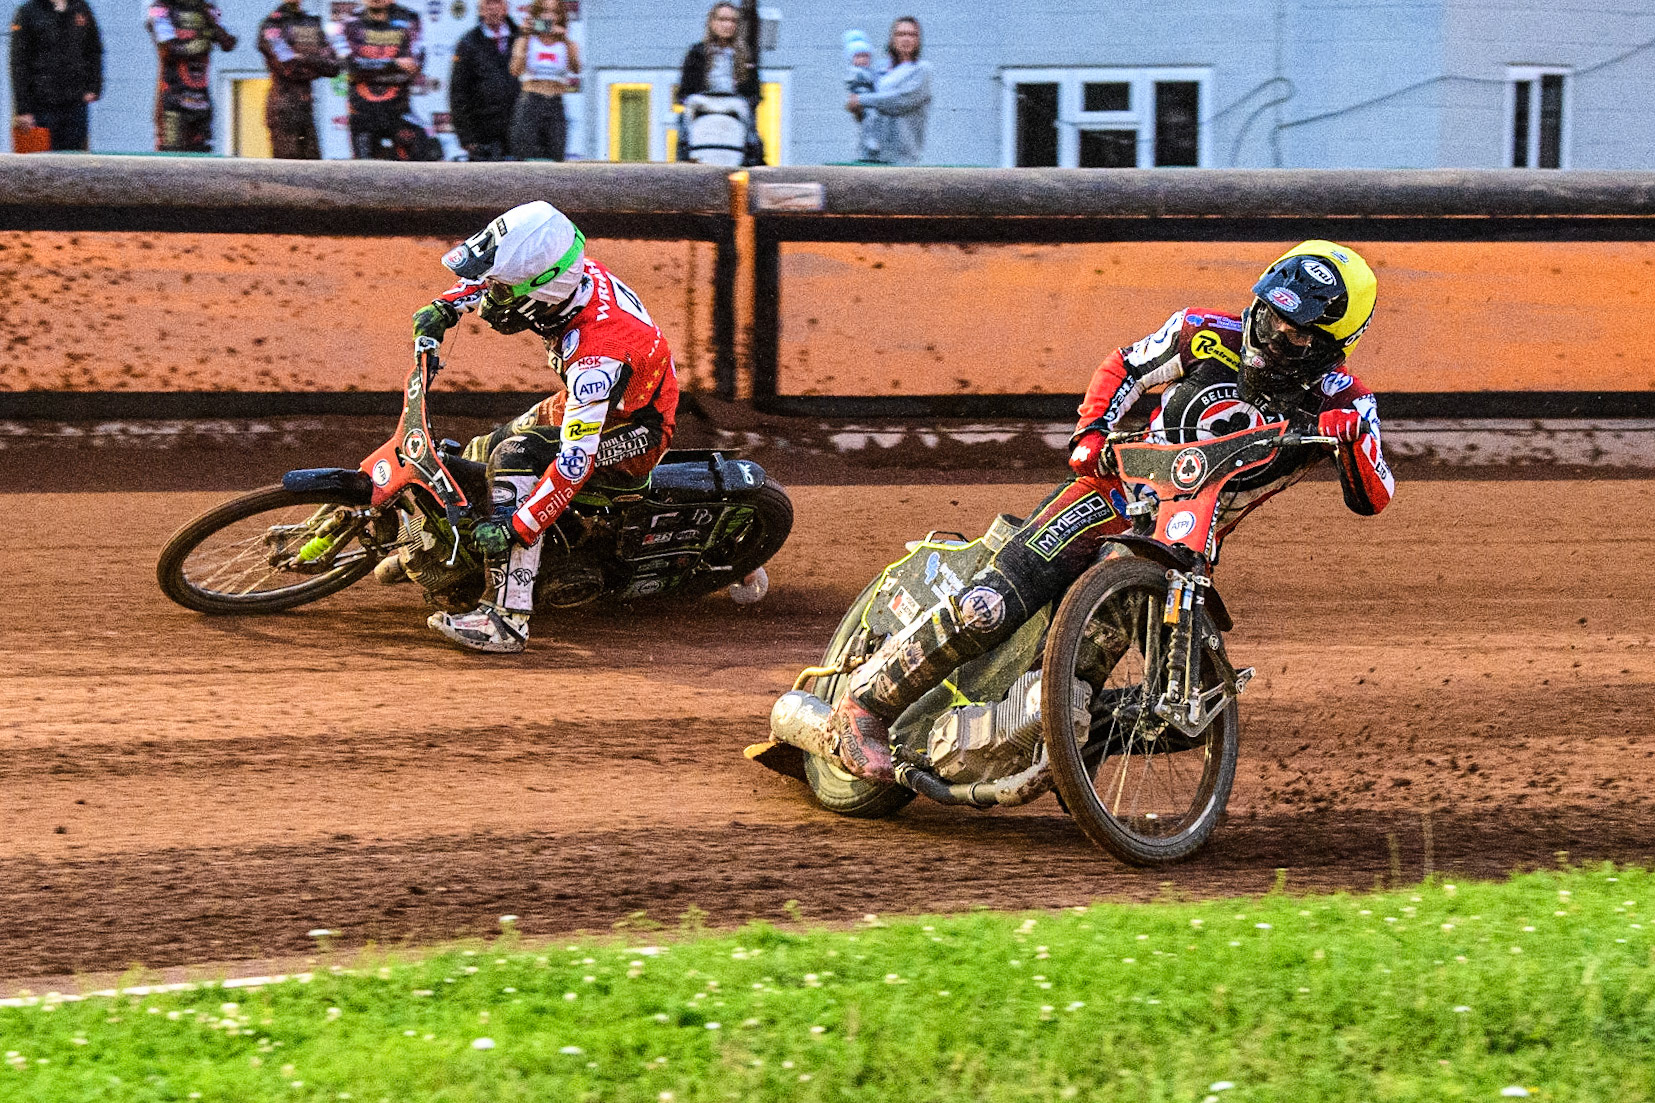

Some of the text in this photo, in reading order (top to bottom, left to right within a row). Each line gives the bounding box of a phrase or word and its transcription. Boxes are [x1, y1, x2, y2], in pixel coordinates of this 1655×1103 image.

[1310, 265, 1333, 283] Arai
[578, 356, 601, 367] NGK
[537, 487, 574, 523] agilia
[1048, 496, 1107, 536] MEDD
